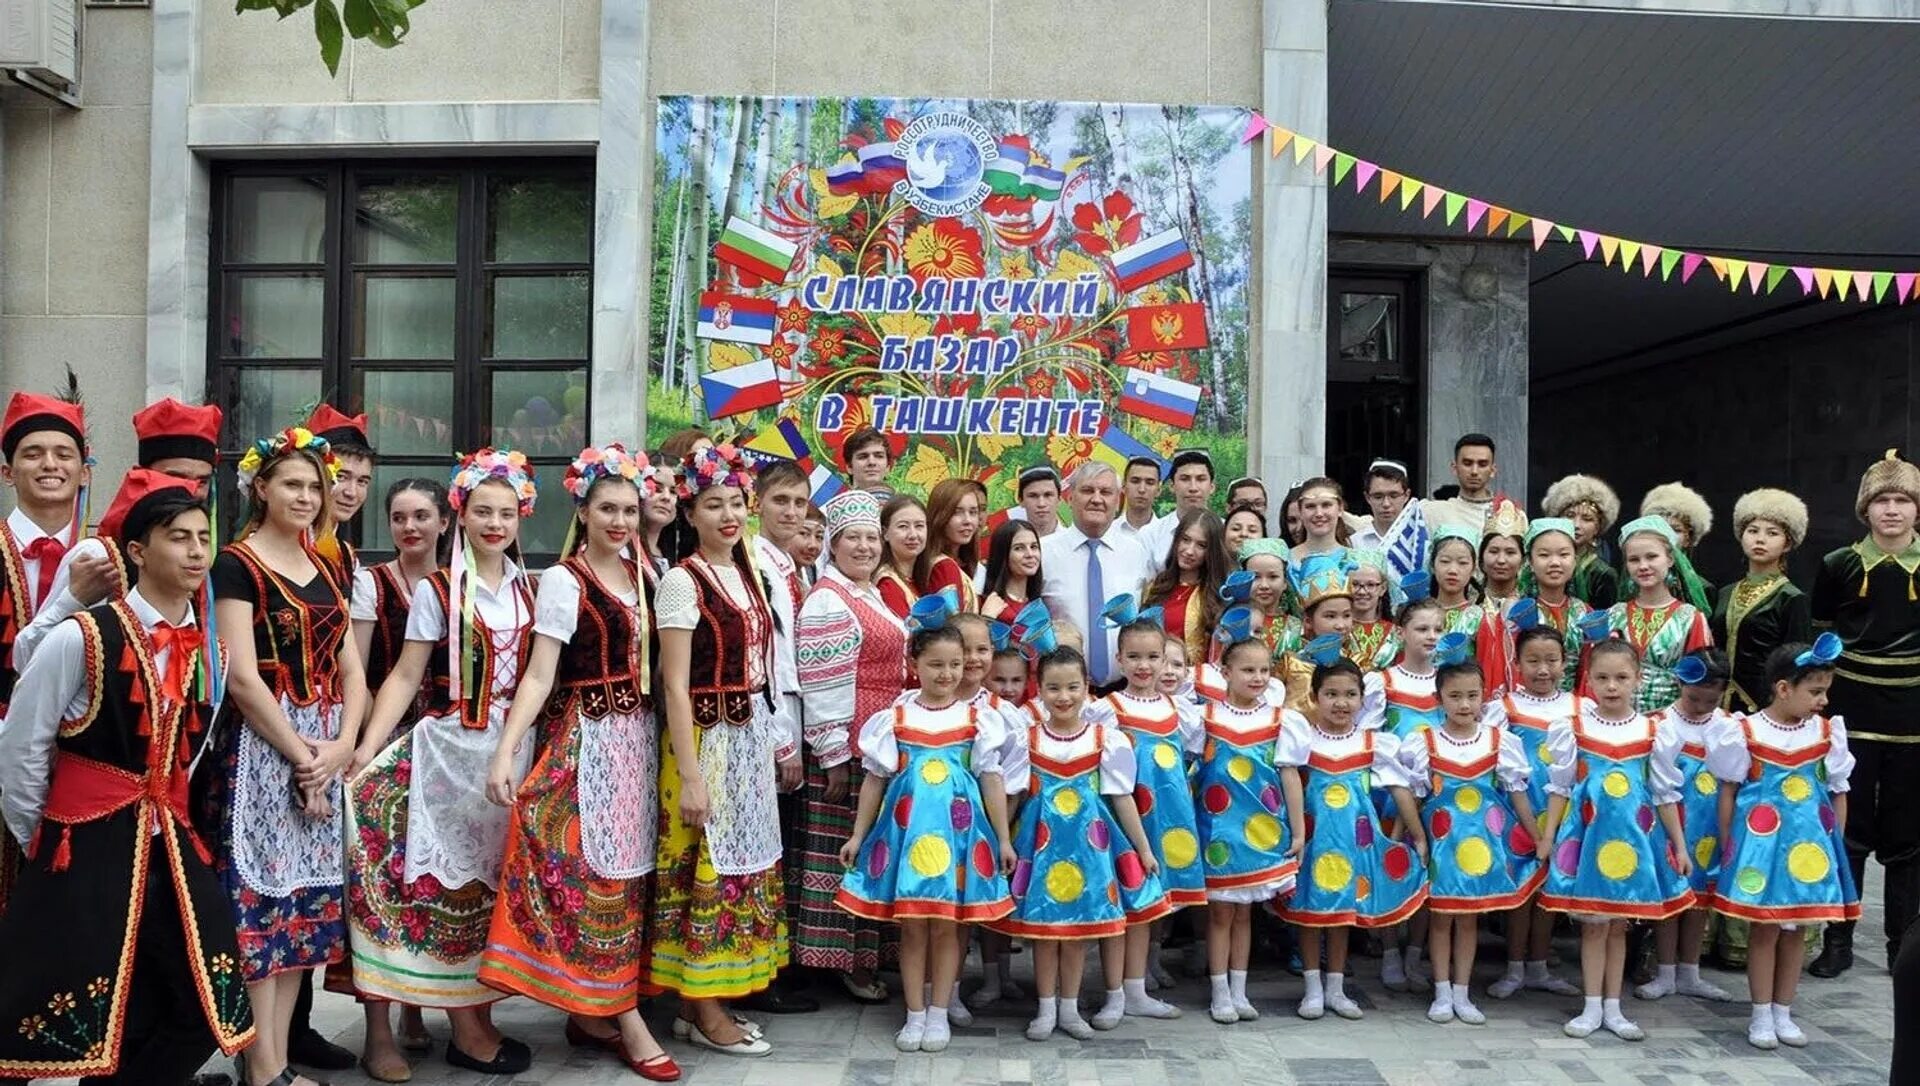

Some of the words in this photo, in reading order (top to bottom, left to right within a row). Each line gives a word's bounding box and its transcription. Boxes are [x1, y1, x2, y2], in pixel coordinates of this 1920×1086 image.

[894, 113, 997, 161] РОССОТРУДНИЧЕСТВО
[896, 181, 908, 193] В
[907, 183, 990, 215] УЗБЕКИСТАНЕ
[804, 274, 1099, 315] СЛАВЯНСКИЙ
[881, 336, 1020, 373] БАЗАР
[817, 395, 847, 431] В
[872, 396, 1103, 436] ТАШКЕНТЕ
